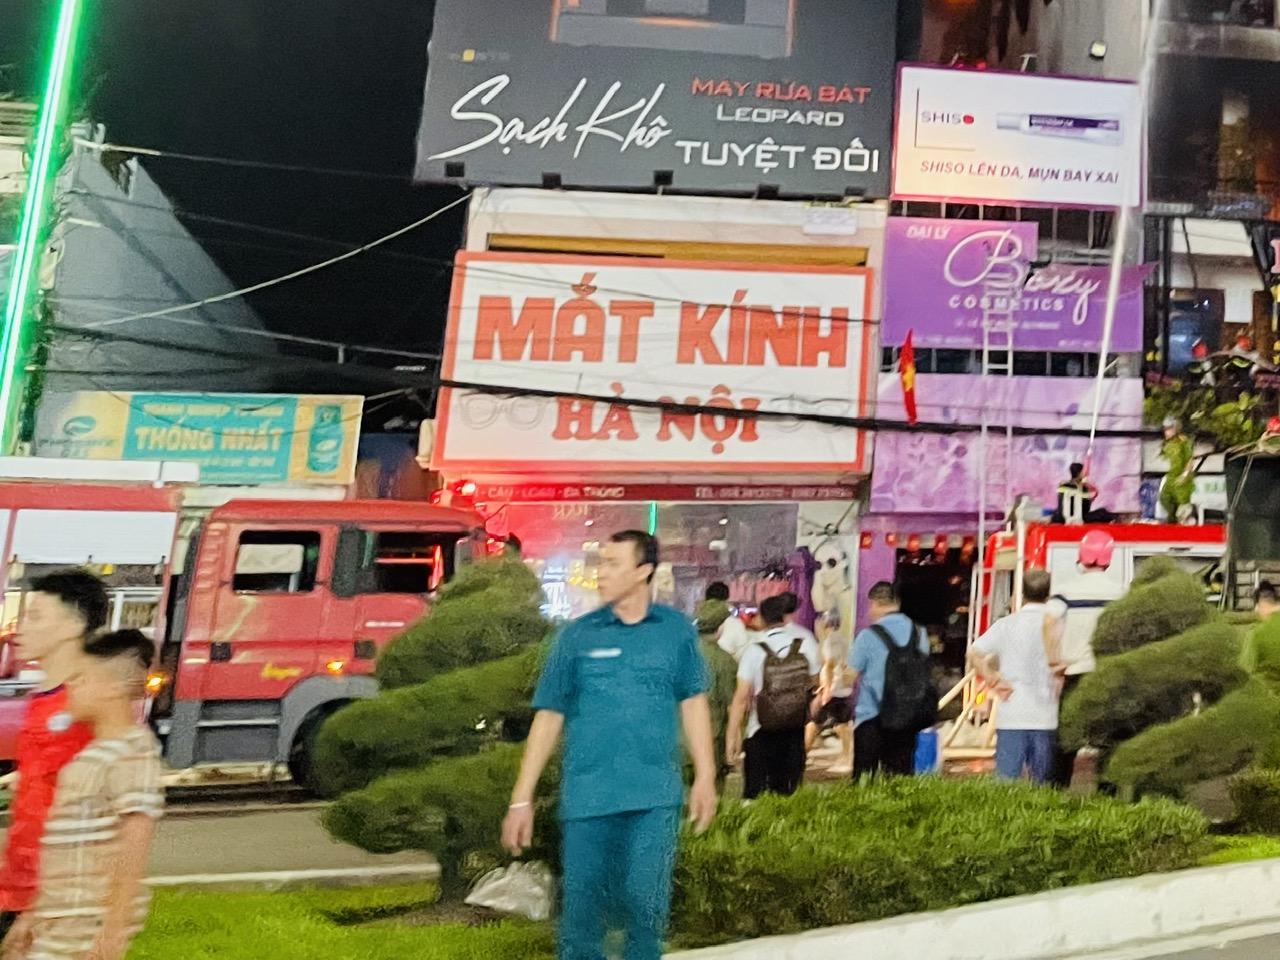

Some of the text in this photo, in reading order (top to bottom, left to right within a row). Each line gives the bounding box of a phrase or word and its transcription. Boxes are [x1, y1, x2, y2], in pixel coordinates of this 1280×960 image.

[428, 74, 673, 159] Sạch Khô
[716, 104, 845, 127] LEOPARD
[675, 136, 880, 174] TUYỆT ĐỐI
[920, 160, 965, 175] SHISO
[472, 272, 850, 368] MẮT KÍNH
[949, 294, 1065, 312] COSMETICS
[552, 382, 761, 454] HÀ NỘI
